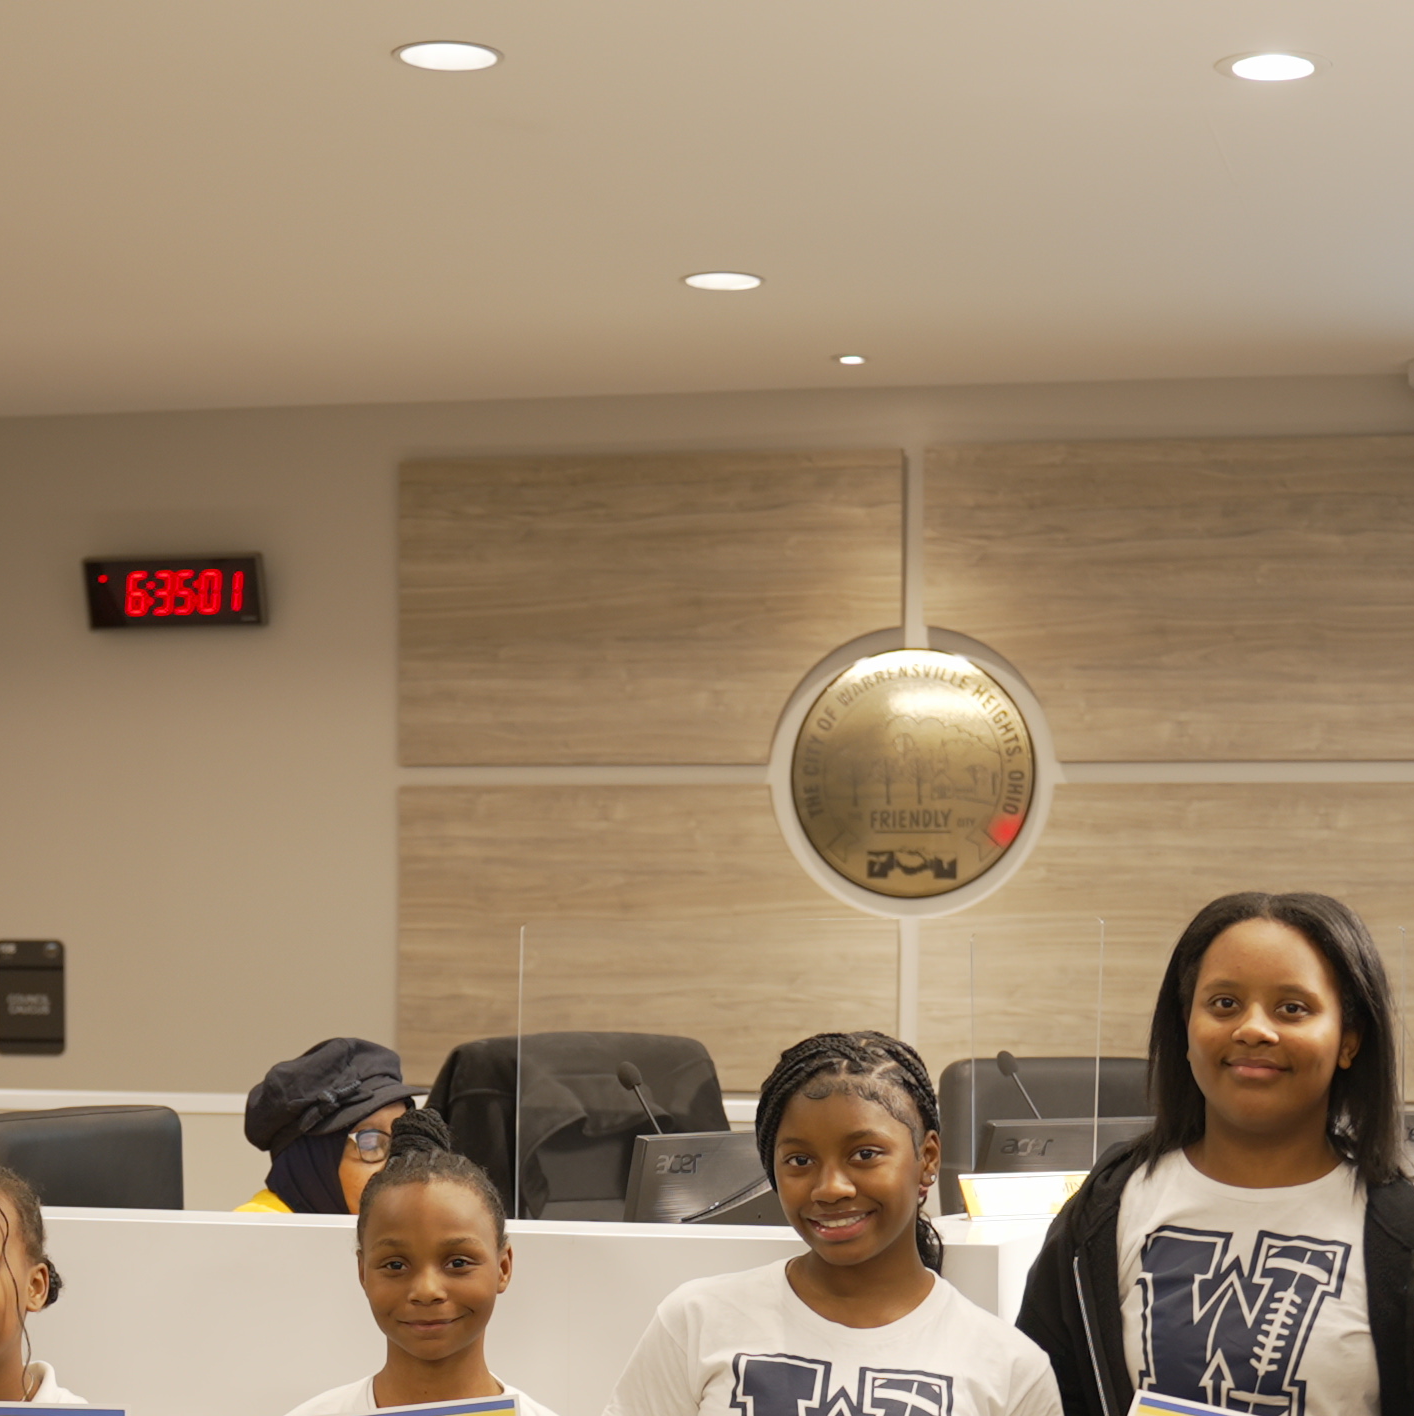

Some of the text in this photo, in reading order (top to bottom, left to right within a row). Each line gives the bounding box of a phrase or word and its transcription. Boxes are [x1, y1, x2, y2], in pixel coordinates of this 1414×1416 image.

[803, 736, 825, 776] CITY
[817, 708, 838, 731] OF
[1002, 770, 1024, 816] OHIO
[869, 808, 952, 829] FRIENDLY
[1000, 1138, 1054, 1157] acer
[655, 1154, 702, 1174] acer
